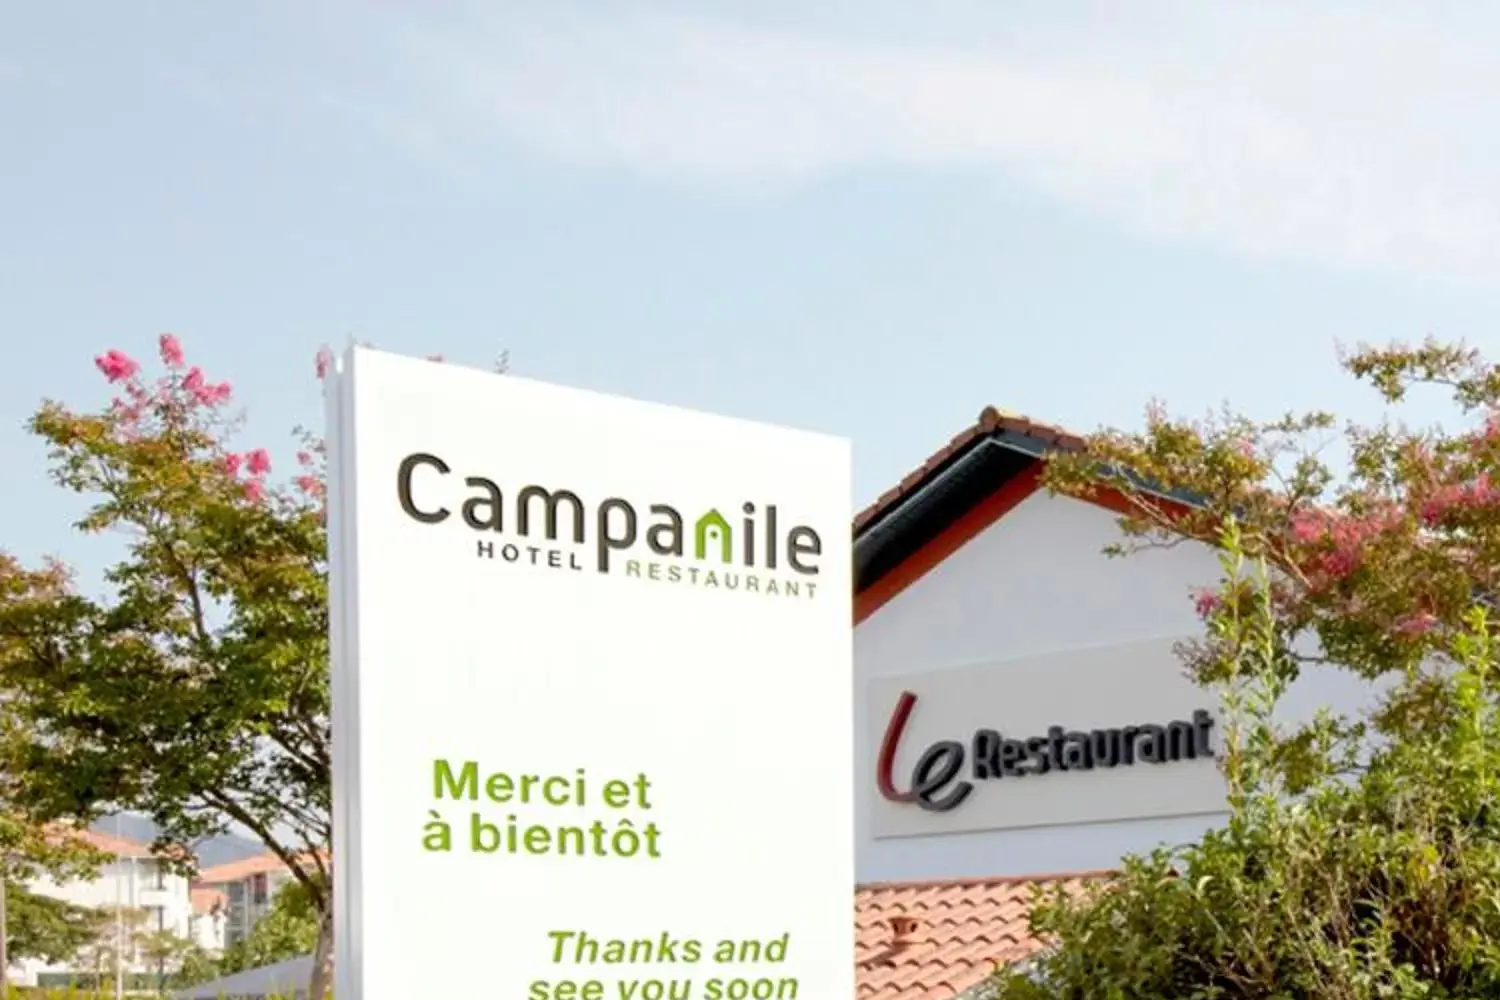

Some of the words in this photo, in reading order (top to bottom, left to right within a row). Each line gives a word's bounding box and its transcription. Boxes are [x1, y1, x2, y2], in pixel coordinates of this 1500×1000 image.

[397, 453, 821, 574] Campanile
[477, 539, 582, 571] HOTEL
[625, 559, 818, 600] RESTAURANT
[876, 690, 974, 813] Le
[971, 708, 1216, 780] Restaurant
[432, 759, 587, 807] Merci
[601, 771, 652, 811] et
[420, 810, 453, 853] à
[469, 814, 662, 860] bientôt
[546, 930, 703, 965] Thanks
[711, 931, 791, 964] and
